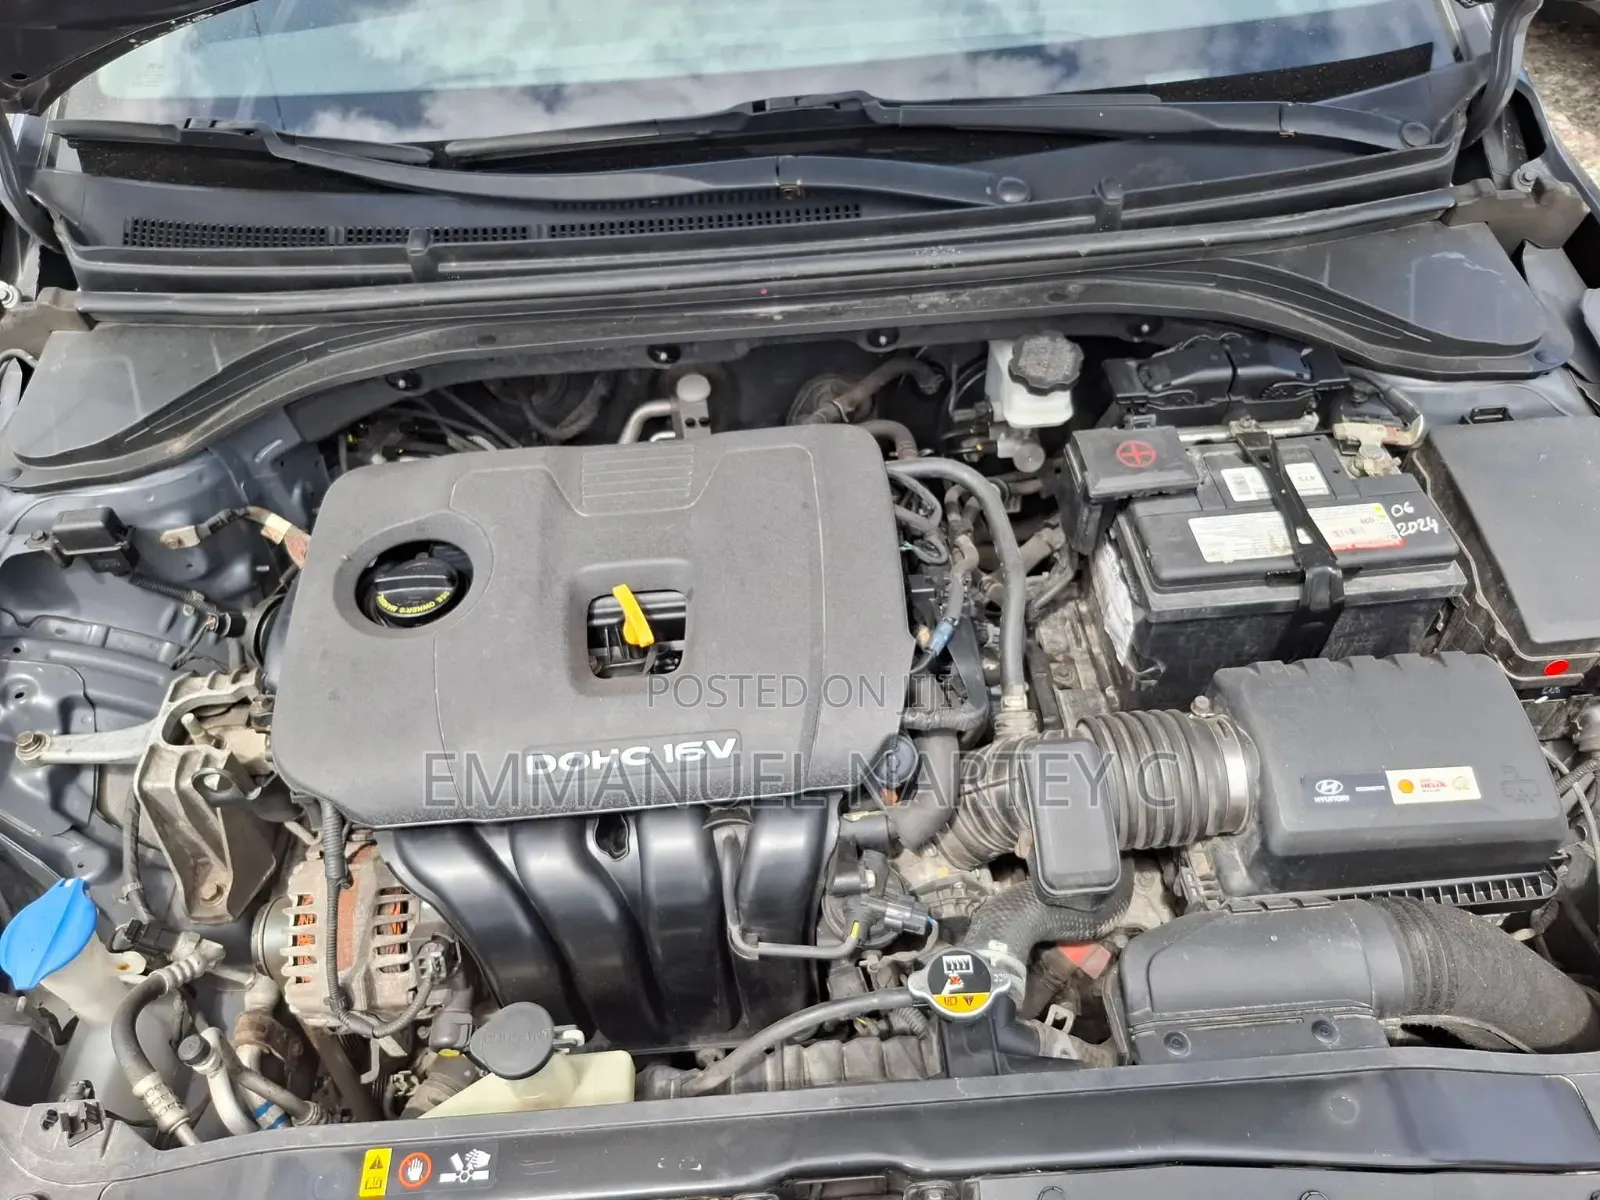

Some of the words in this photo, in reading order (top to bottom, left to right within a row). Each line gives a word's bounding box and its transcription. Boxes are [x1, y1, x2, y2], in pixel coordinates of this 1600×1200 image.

[1391, 501, 1414, 517] 06
[1396, 516, 1438, 536] 2024
[399, 601, 436, 613] OWNER'S
[526, 746, 651, 775] DOHC
[663, 738, 737, 763] 16V
[1313, 794, 1350, 804] HYUNDAI
